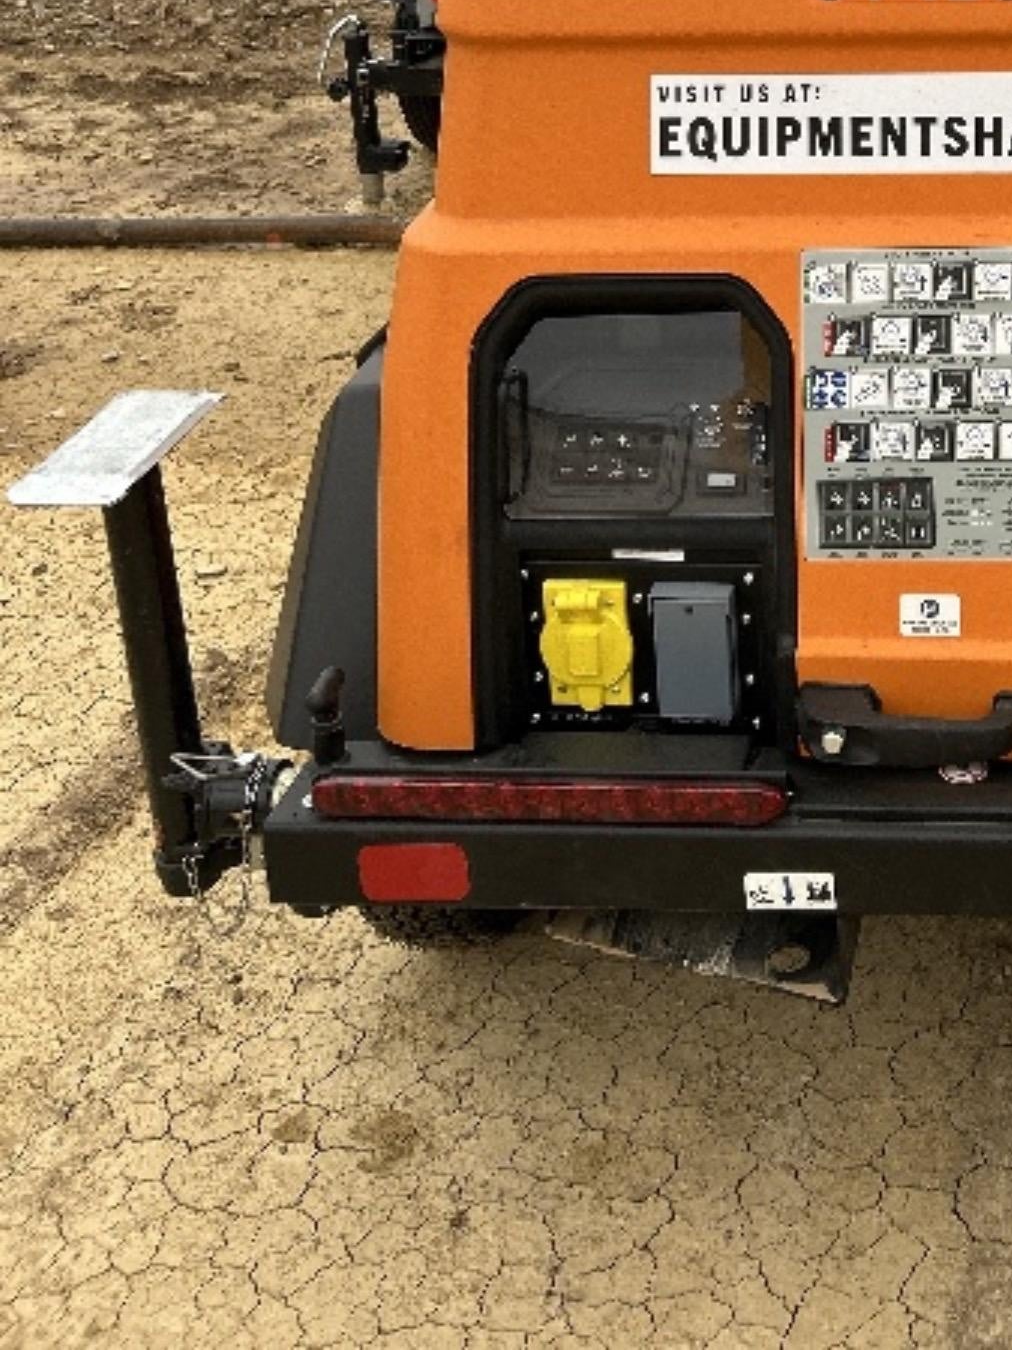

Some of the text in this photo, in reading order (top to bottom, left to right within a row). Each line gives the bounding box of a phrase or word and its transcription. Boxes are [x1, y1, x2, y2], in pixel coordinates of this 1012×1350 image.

[657, 83, 820, 103] VISIT US AT:
